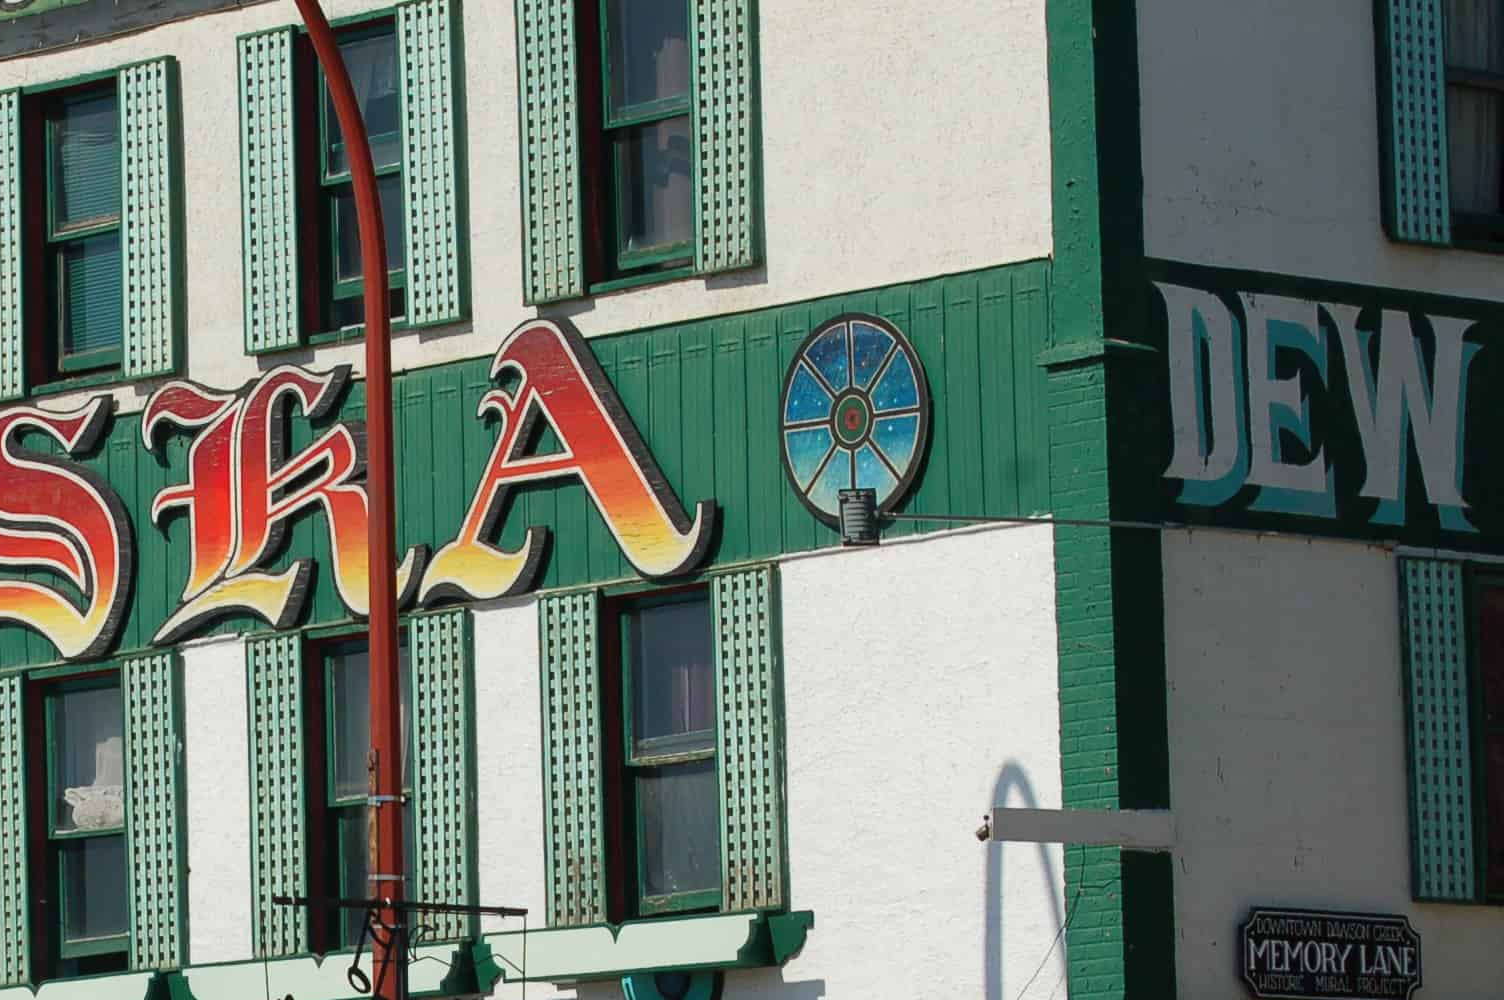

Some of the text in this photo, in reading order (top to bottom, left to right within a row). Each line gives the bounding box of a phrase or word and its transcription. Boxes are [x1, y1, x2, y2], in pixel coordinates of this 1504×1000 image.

[1152, 281, 1484, 533] DEW
[1256, 917, 1405, 942] DOWNTOWN DAWSON CREEK
[1247, 938, 1417, 977] MEMORY LANE
[1258, 975, 1411, 996] HISTORIC MURAL PROJECT
